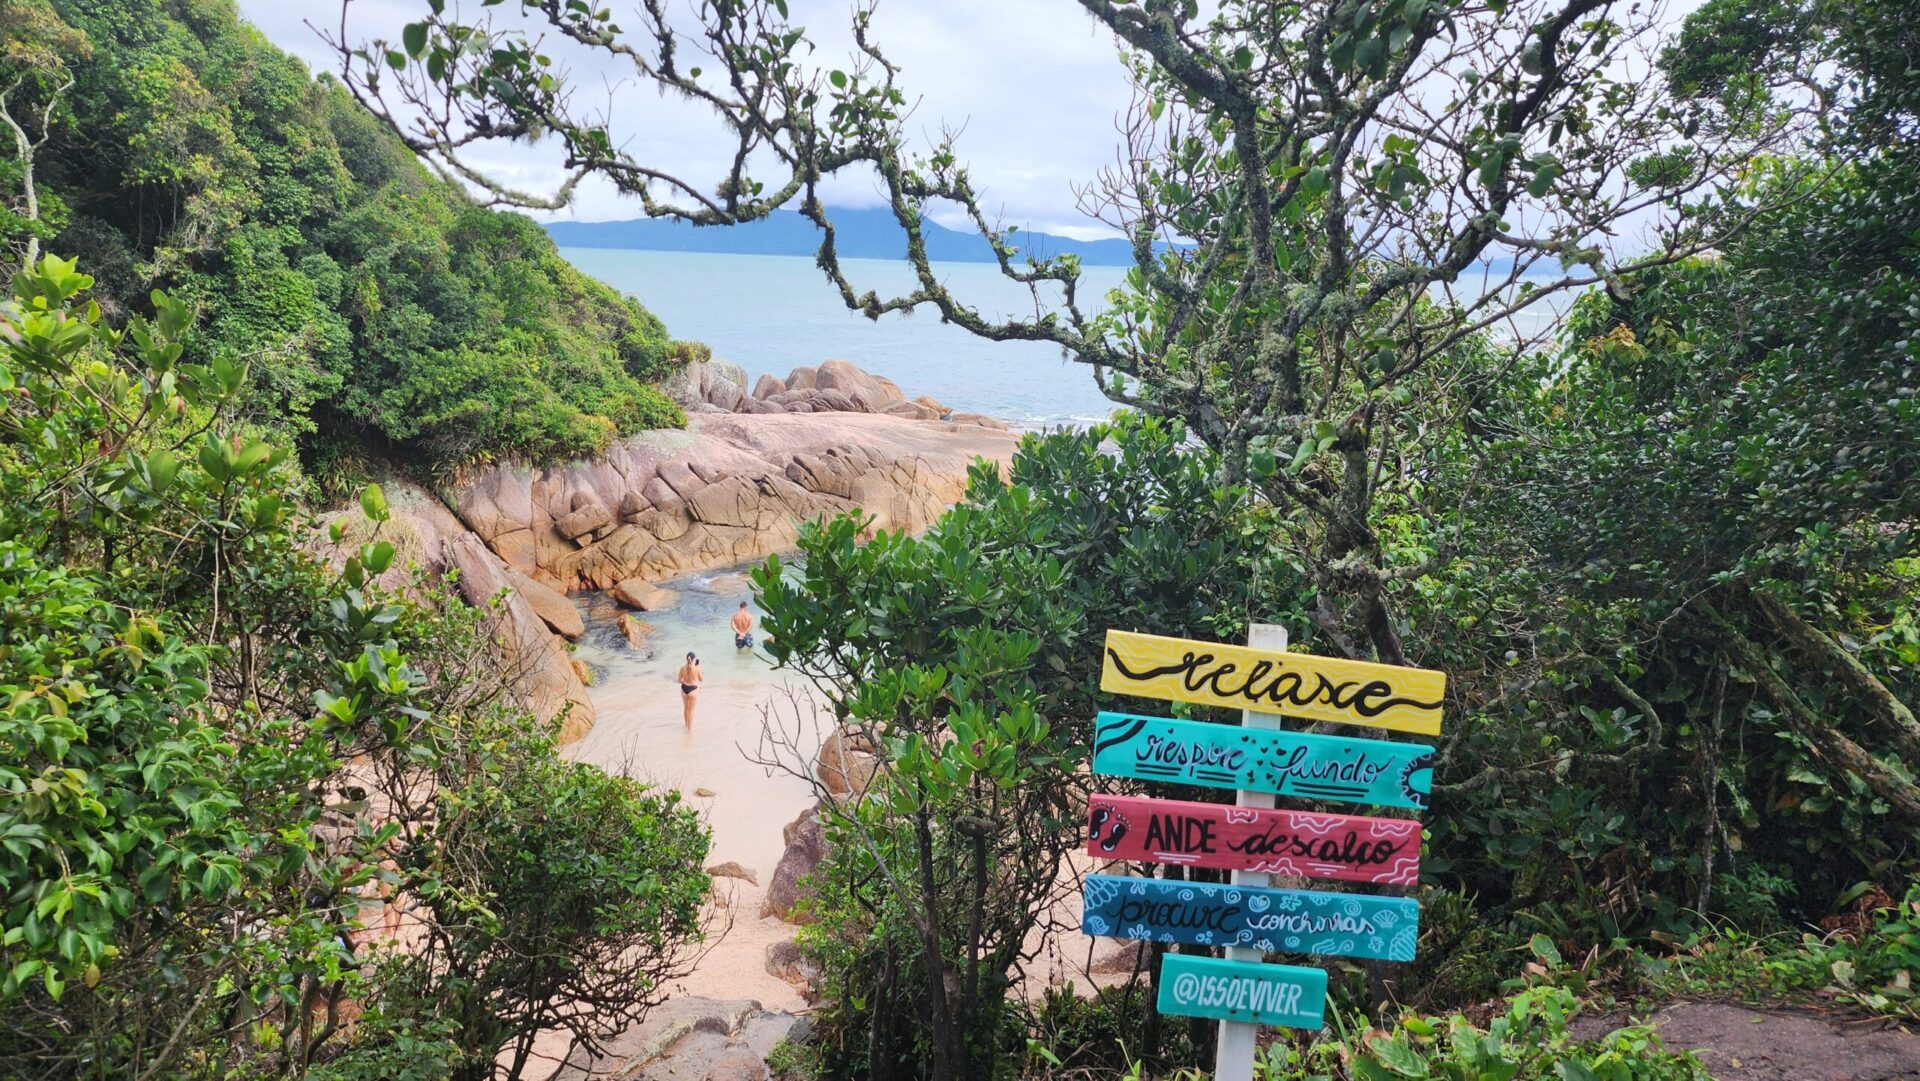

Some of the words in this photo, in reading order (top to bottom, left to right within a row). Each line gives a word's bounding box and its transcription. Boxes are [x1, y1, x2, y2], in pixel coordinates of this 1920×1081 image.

[1181, 651, 1396, 718] relaxe
[1136, 734, 1249, 777] respire
[1270, 745, 1396, 791] fundo
[1144, 813, 1217, 854] ANDE
[1226, 819, 1410, 872] descalço
[1105, 894, 1242, 935] procure
[1246, 911, 1375, 935] conchinhas
